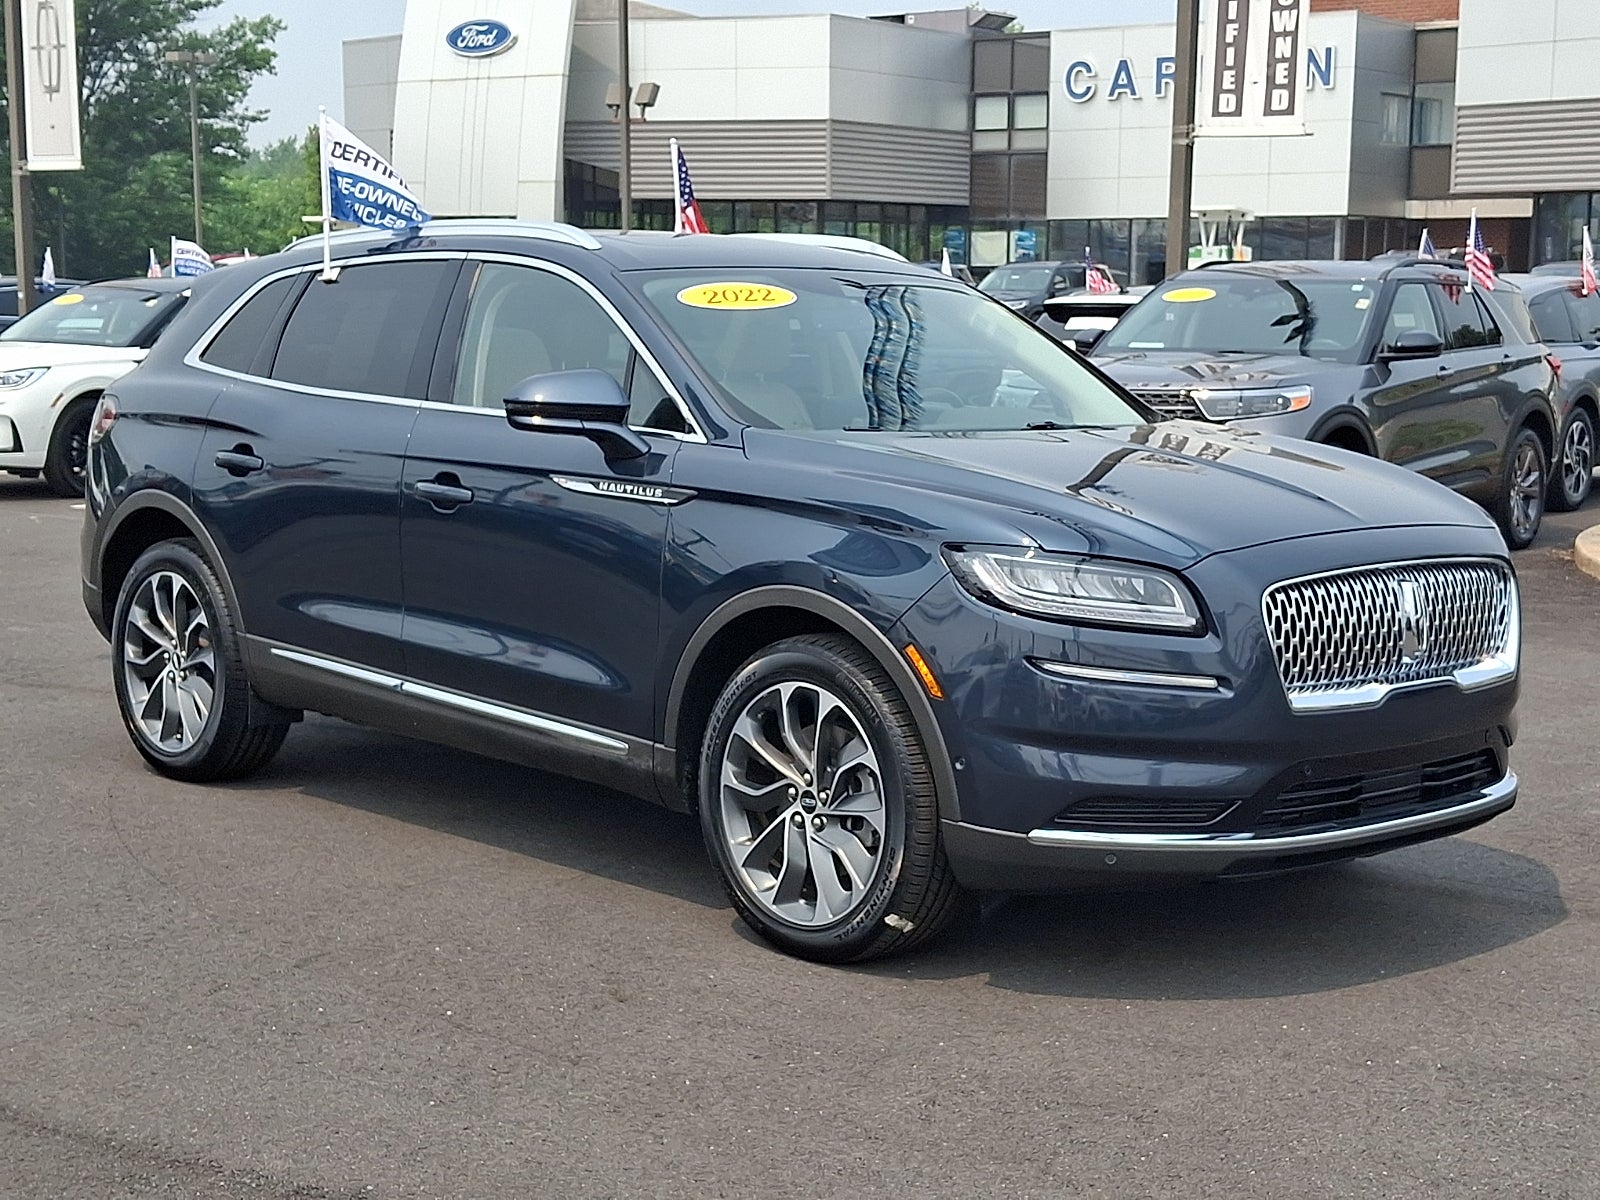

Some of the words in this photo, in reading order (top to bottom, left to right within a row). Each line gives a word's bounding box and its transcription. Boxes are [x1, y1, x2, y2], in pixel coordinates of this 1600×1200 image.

[457, 24, 498, 48] Ford
[331, 141, 409, 190] CERTIFI
[337, 175, 423, 222] E-OWNED
[703, 288, 776, 304] 2022
[599, 481, 663, 497] NAUTILUS
